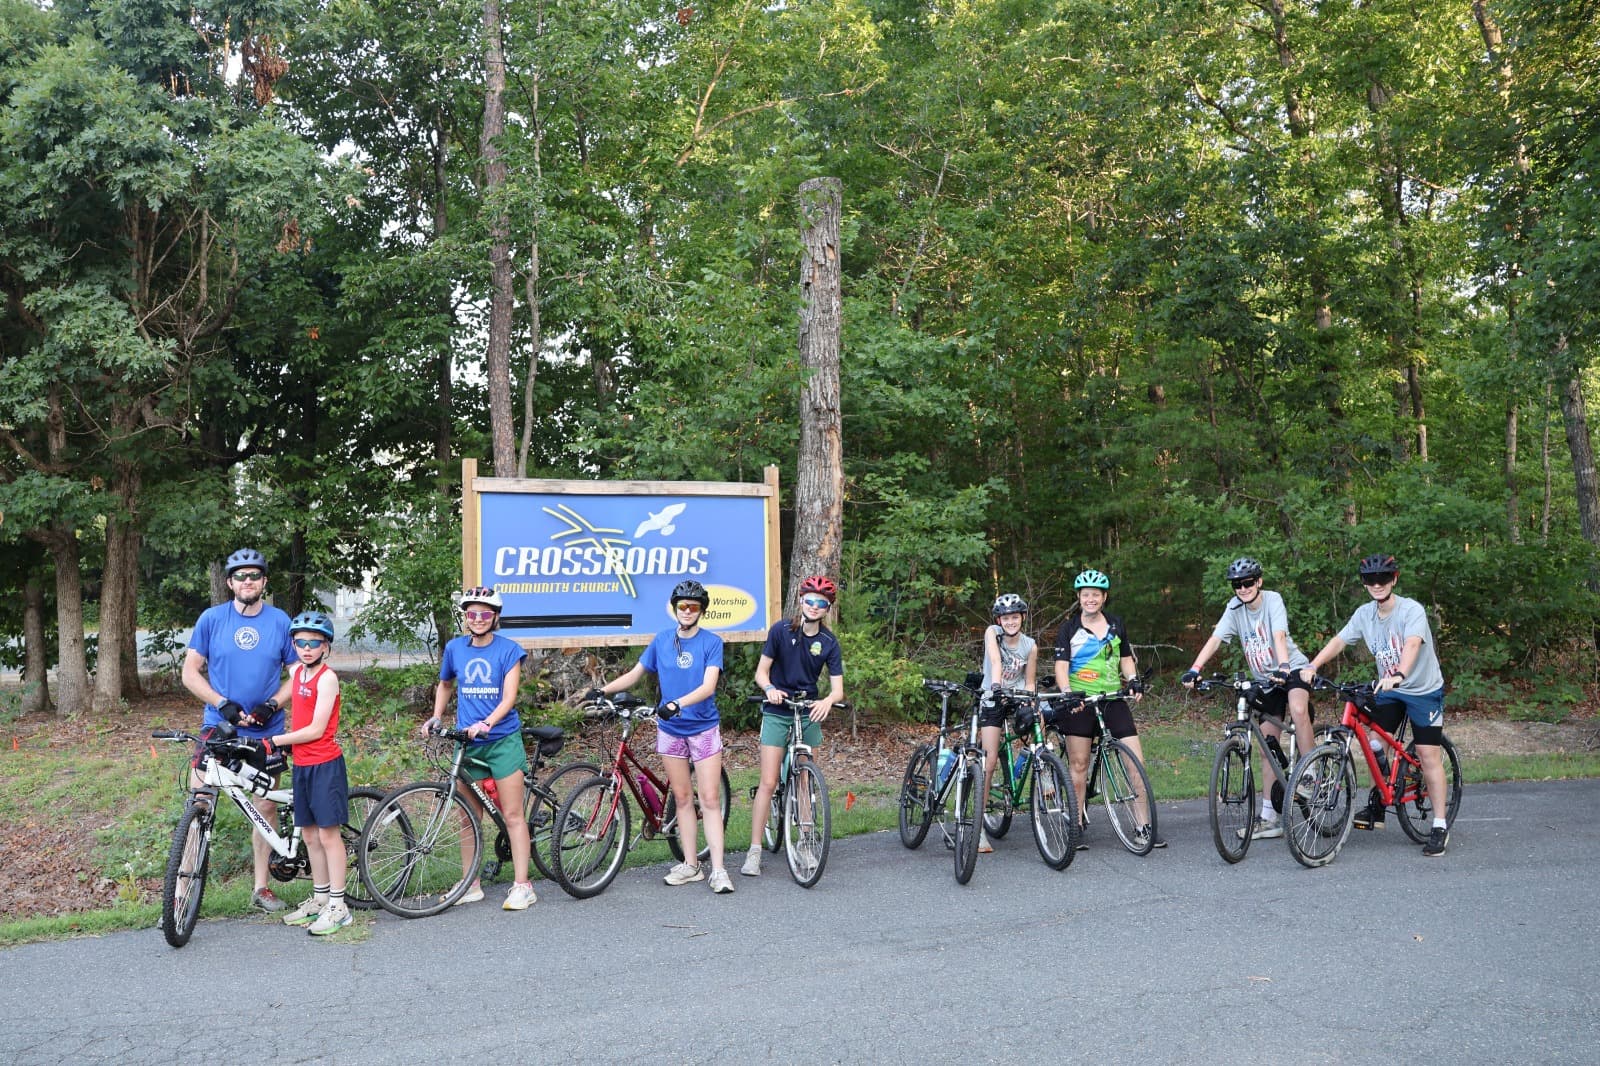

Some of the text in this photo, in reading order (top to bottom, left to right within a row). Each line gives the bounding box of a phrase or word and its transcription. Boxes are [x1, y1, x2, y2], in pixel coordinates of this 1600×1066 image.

[494, 546, 709, 576] CROSSROADS
[493, 581, 620, 594] COMMUNITY CHURCH
[713, 597, 748, 606] Worship
[244, 801, 273, 834] mongoose
